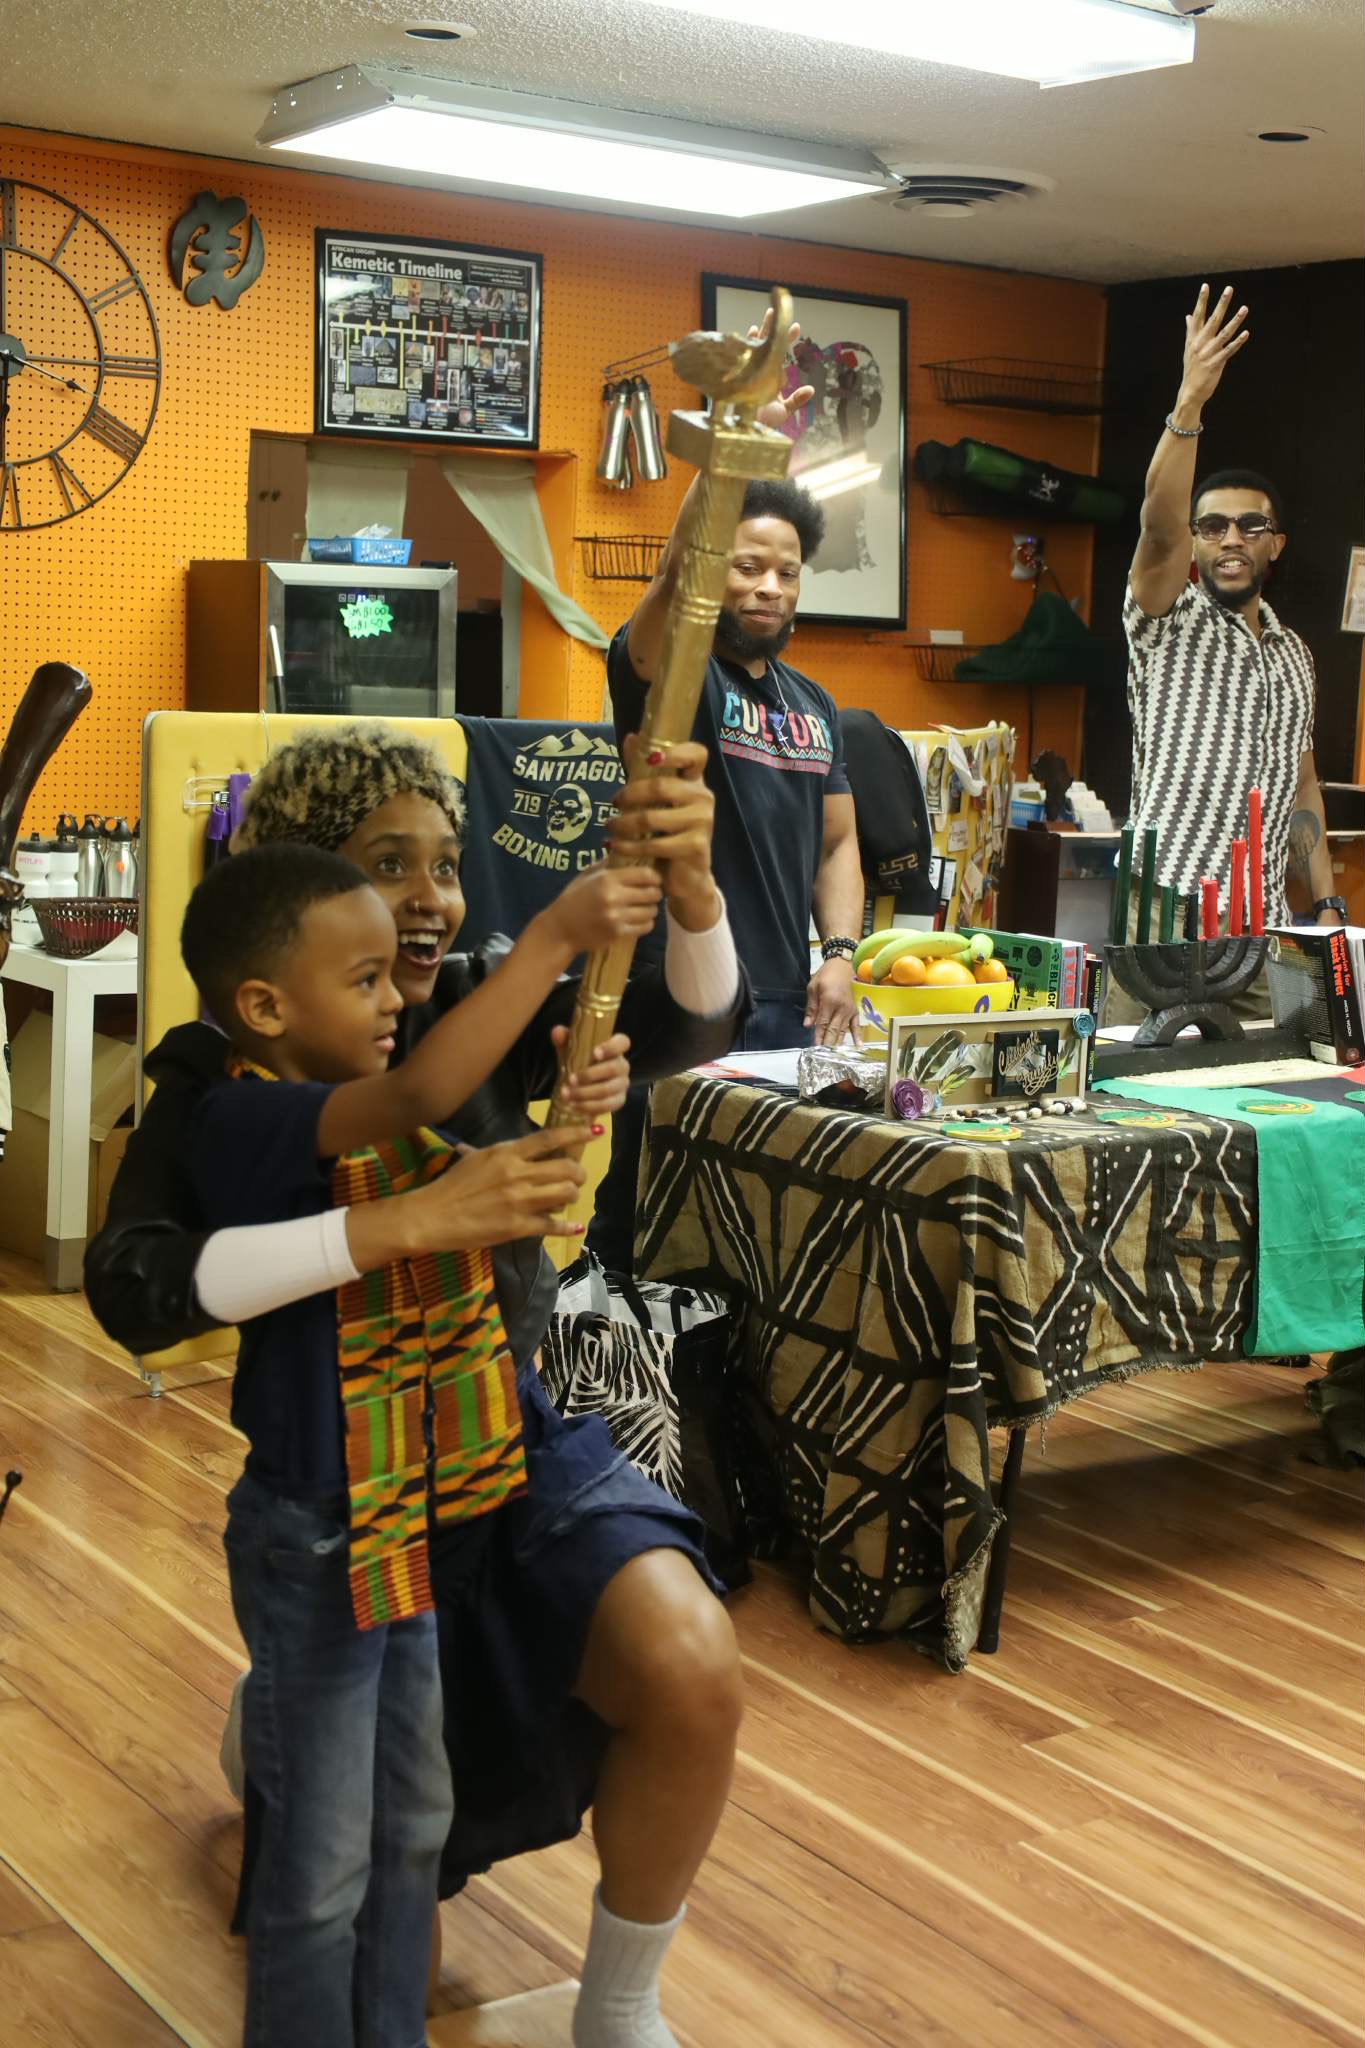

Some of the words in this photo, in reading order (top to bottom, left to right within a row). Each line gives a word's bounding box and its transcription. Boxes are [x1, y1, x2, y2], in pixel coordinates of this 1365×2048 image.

[331, 252, 395, 272] Kemetic
[398, 259, 463, 280] Timeline
[723, 691, 833, 753] CULTURE
[514, 792, 541, 814] 719
[492, 823, 570, 871] BOXING
[1330, 936, 1342, 963] Black
[1339, 935, 1349, 972] Blueprint
[1344, 974, 1352, 988] for
[1047, 971, 1059, 1008] BLACK
[1332, 963, 1345, 996] Power
